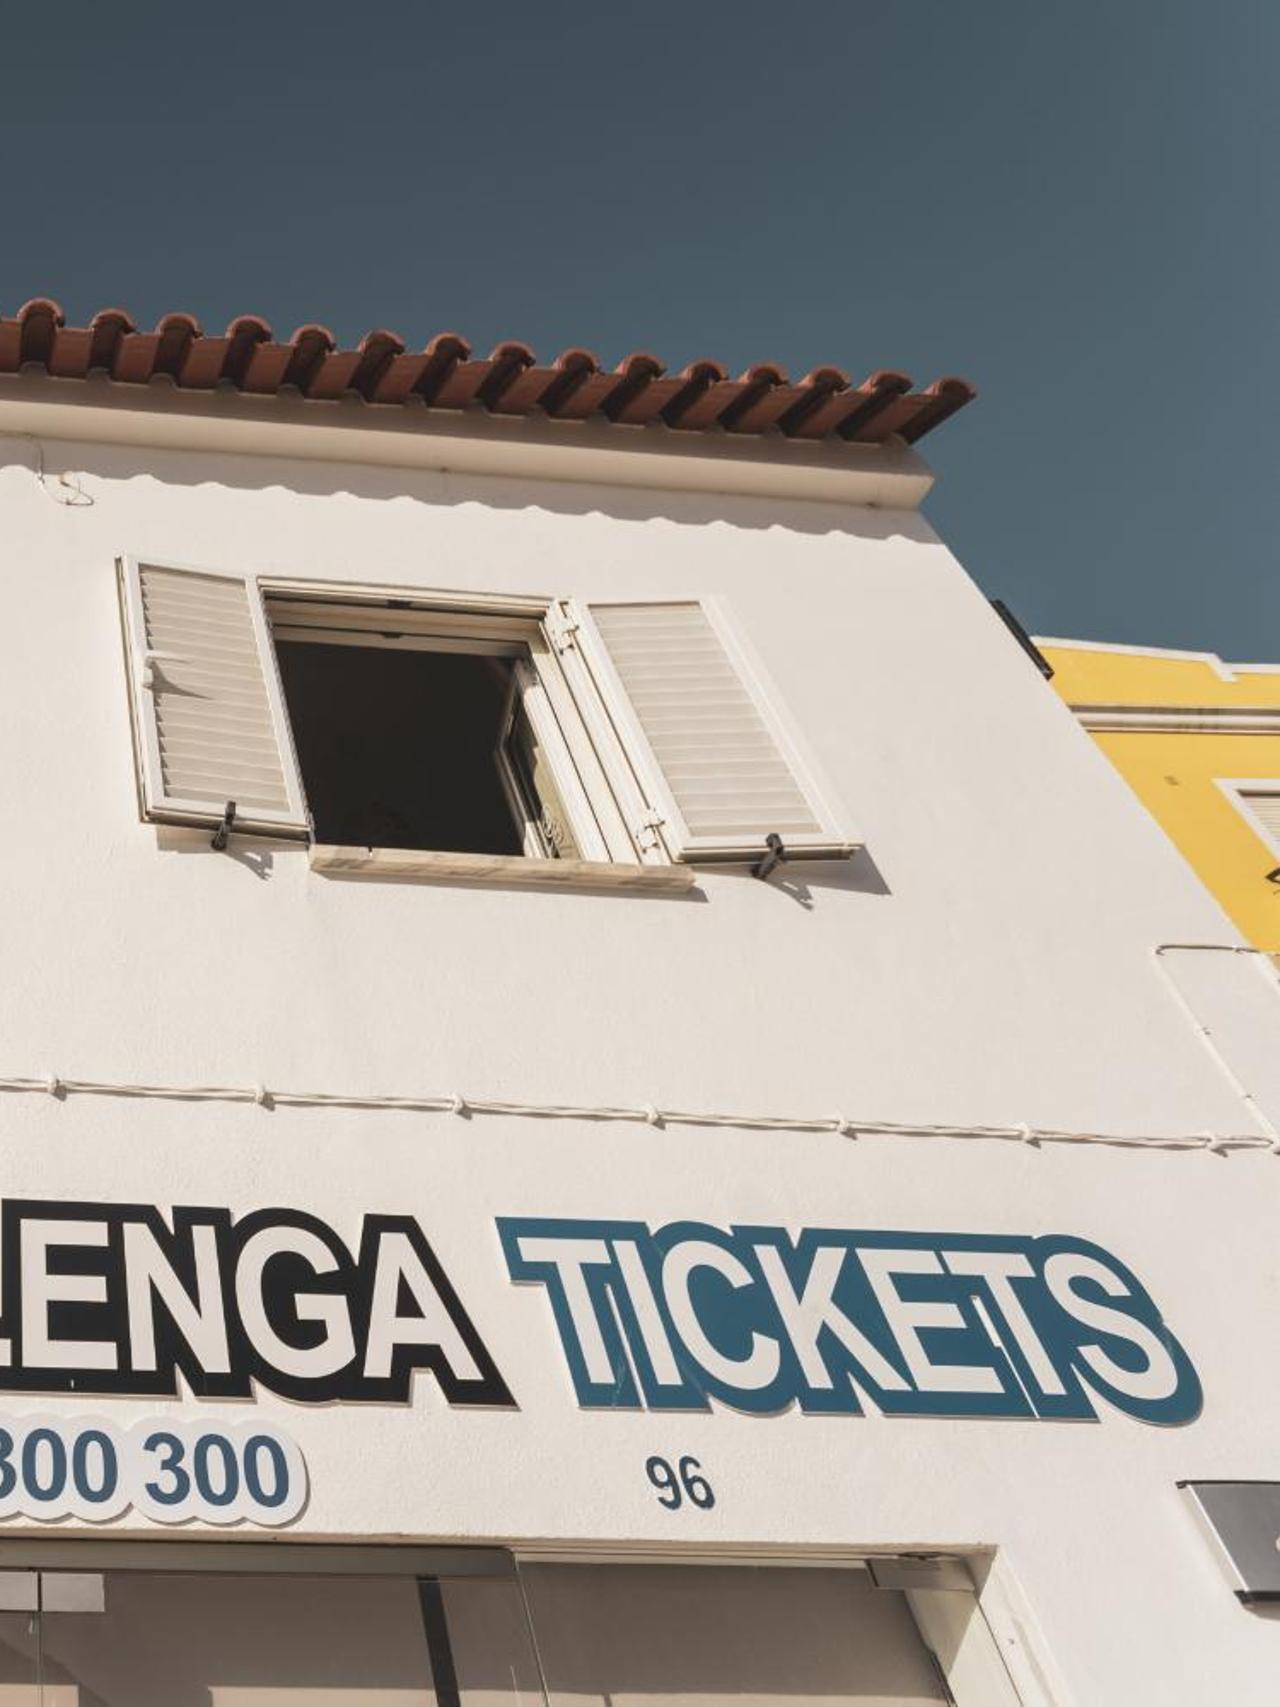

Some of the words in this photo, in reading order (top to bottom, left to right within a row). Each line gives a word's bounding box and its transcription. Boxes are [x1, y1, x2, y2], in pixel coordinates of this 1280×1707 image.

[517, 1237, 1178, 1400] TICKETS
[144, 1432, 289, 1507] 300
[646, 1454, 717, 1511] 96
